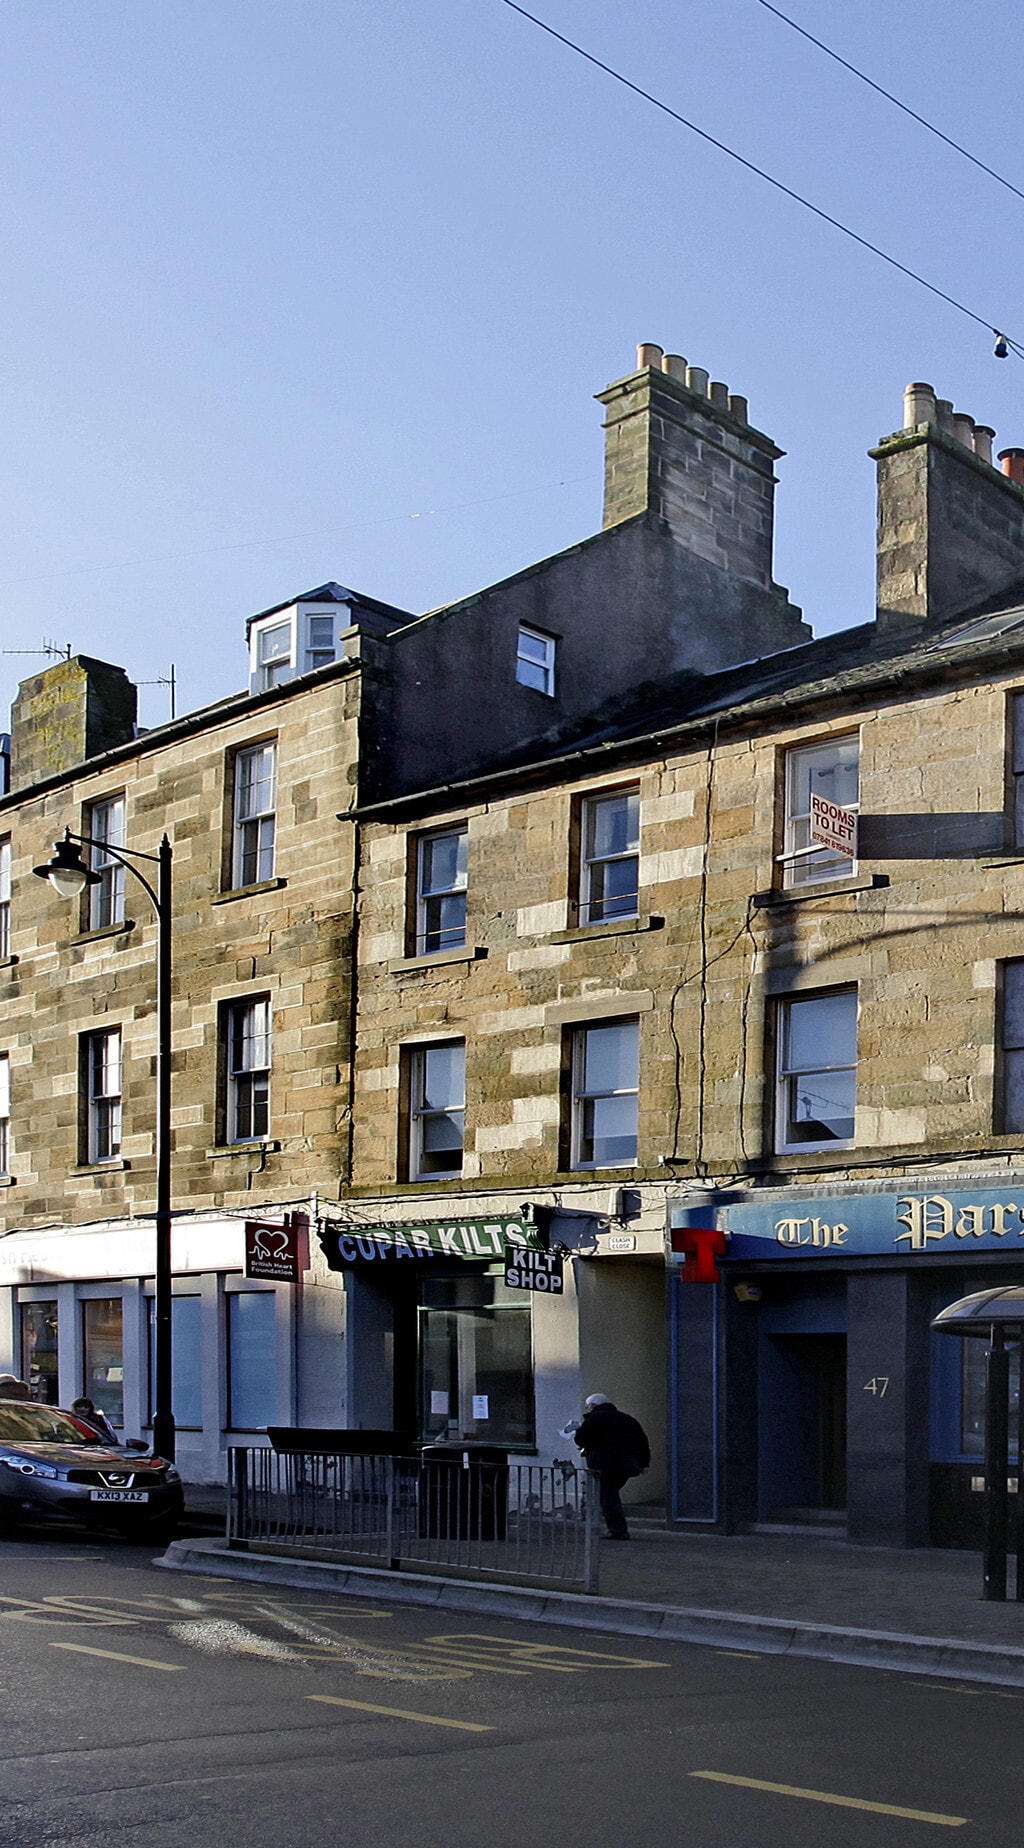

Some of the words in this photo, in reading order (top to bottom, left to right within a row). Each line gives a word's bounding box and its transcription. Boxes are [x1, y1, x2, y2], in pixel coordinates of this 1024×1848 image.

[812, 796, 855, 828] ROOMS
[814, 811, 830, 830] TO
[832, 821, 854, 841] LET
[338, 1228, 435, 1262] CUPAR
[437, 1222, 528, 1256] KILTS
[775, 1215, 849, 1251] The
[251, 1260, 273, 1268] British
[273, 1262, 293, 1270] Heart
[251, 1266, 294, 1275] Foundation
[512, 1249, 556, 1272] KILT
[506, 1267, 562, 1293] SHOP
[863, 1377, 889, 1398] 47
[97, 1491, 120, 1500] KX13
[123, 1492, 143, 1501] XAZ
